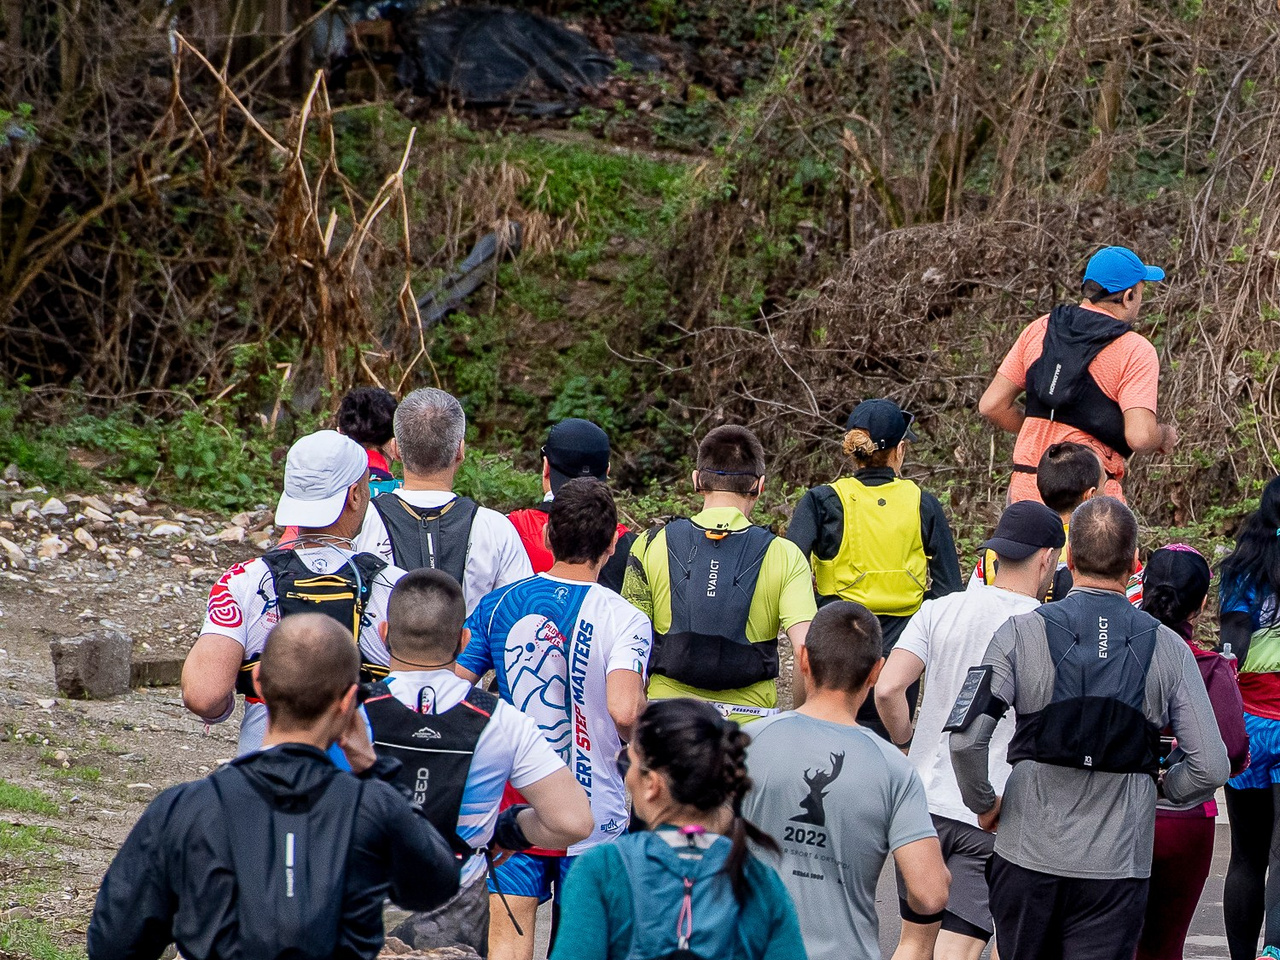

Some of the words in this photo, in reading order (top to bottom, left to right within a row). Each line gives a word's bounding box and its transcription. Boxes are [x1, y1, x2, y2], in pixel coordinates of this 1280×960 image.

[706, 559, 720, 597] EVADICT
[1098, 616, 1109, 659] EVADICT
[571, 619, 594, 705] MATTERS
[574, 703, 591, 752] STEP
[783, 826, 827, 848] 2022
